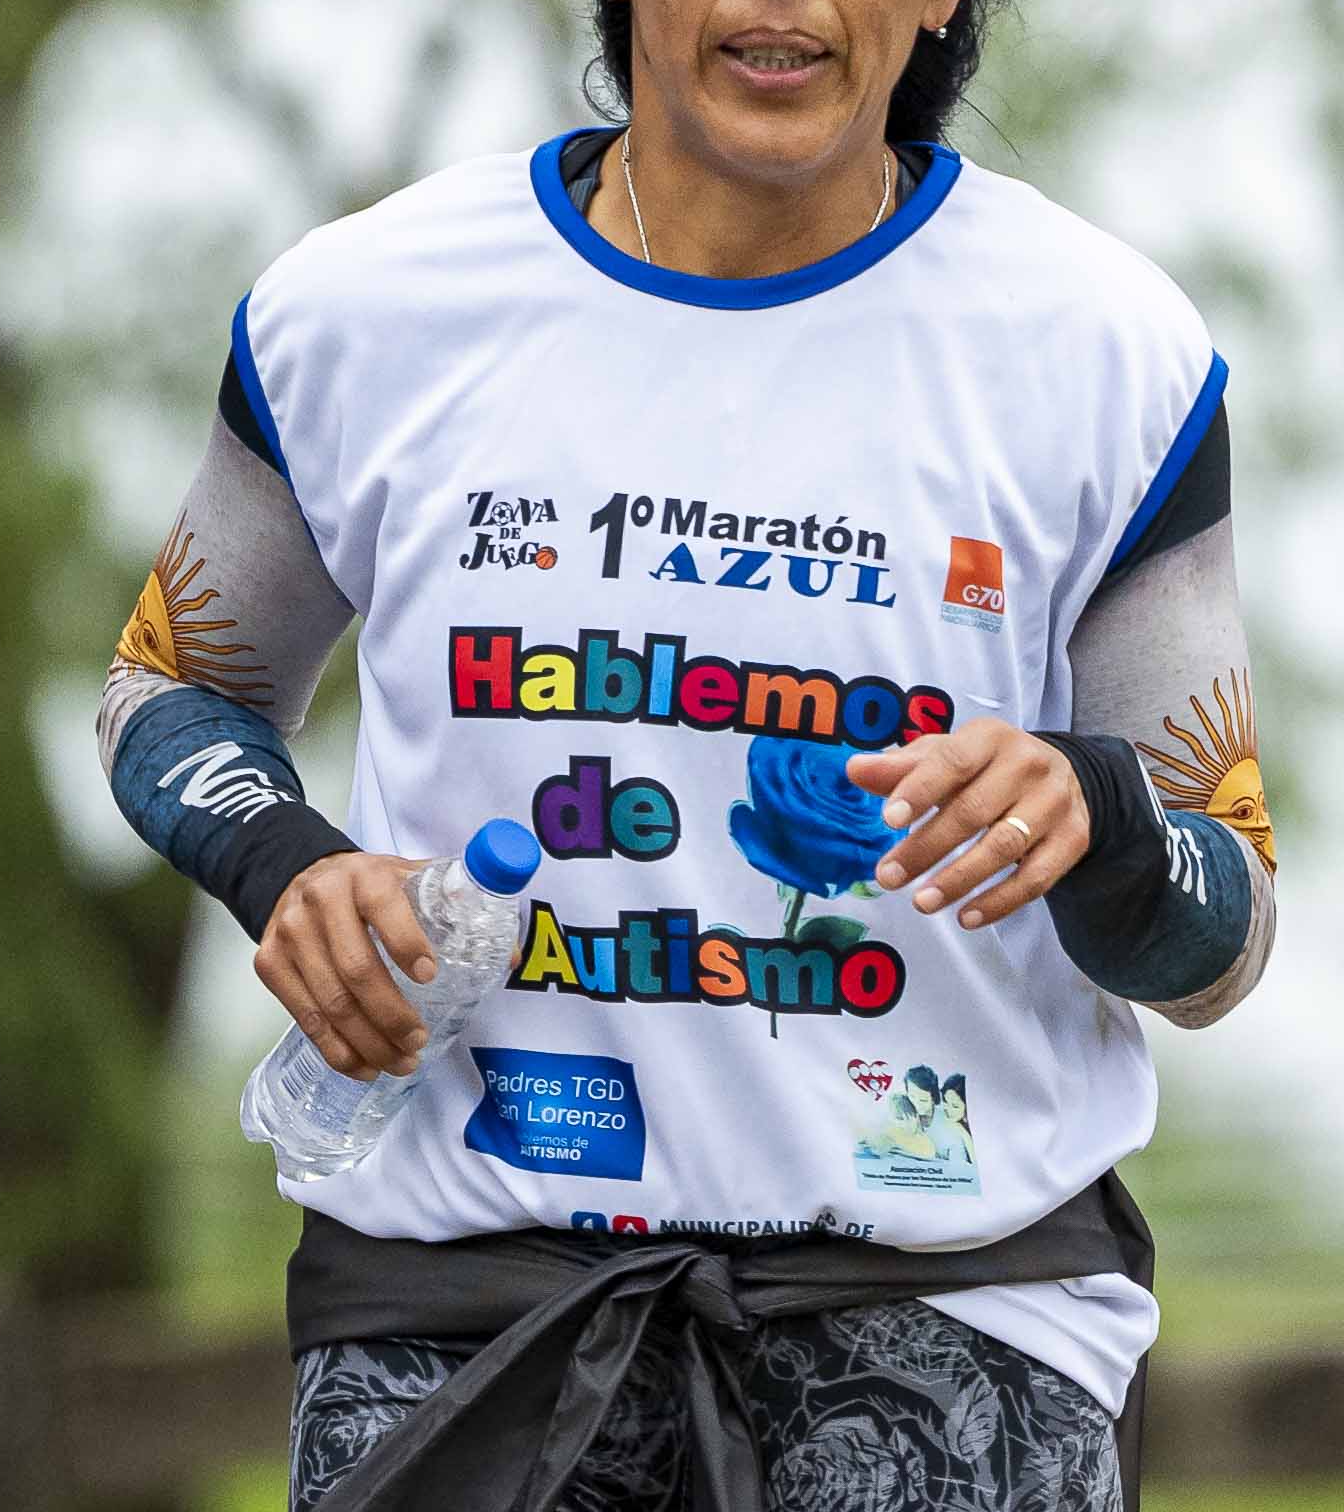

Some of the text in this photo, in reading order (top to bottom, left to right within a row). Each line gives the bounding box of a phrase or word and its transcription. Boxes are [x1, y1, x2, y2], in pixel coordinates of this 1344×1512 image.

[499, 527, 522, 540] DE
[659, 496, 886, 561] Maratón
[648, 541, 897, 608] AZUL
[961, 583, 1004, 610] G70
[450, 626, 956, 746] Hablemos
[532, 755, 680, 862] de
[506, 898, 907, 1018] Autismo
[486, 1069, 625, 1102] Padres TGD
[527, 1100, 627, 1131] Lorenzo
[844, 1222, 875, 1240] DE
